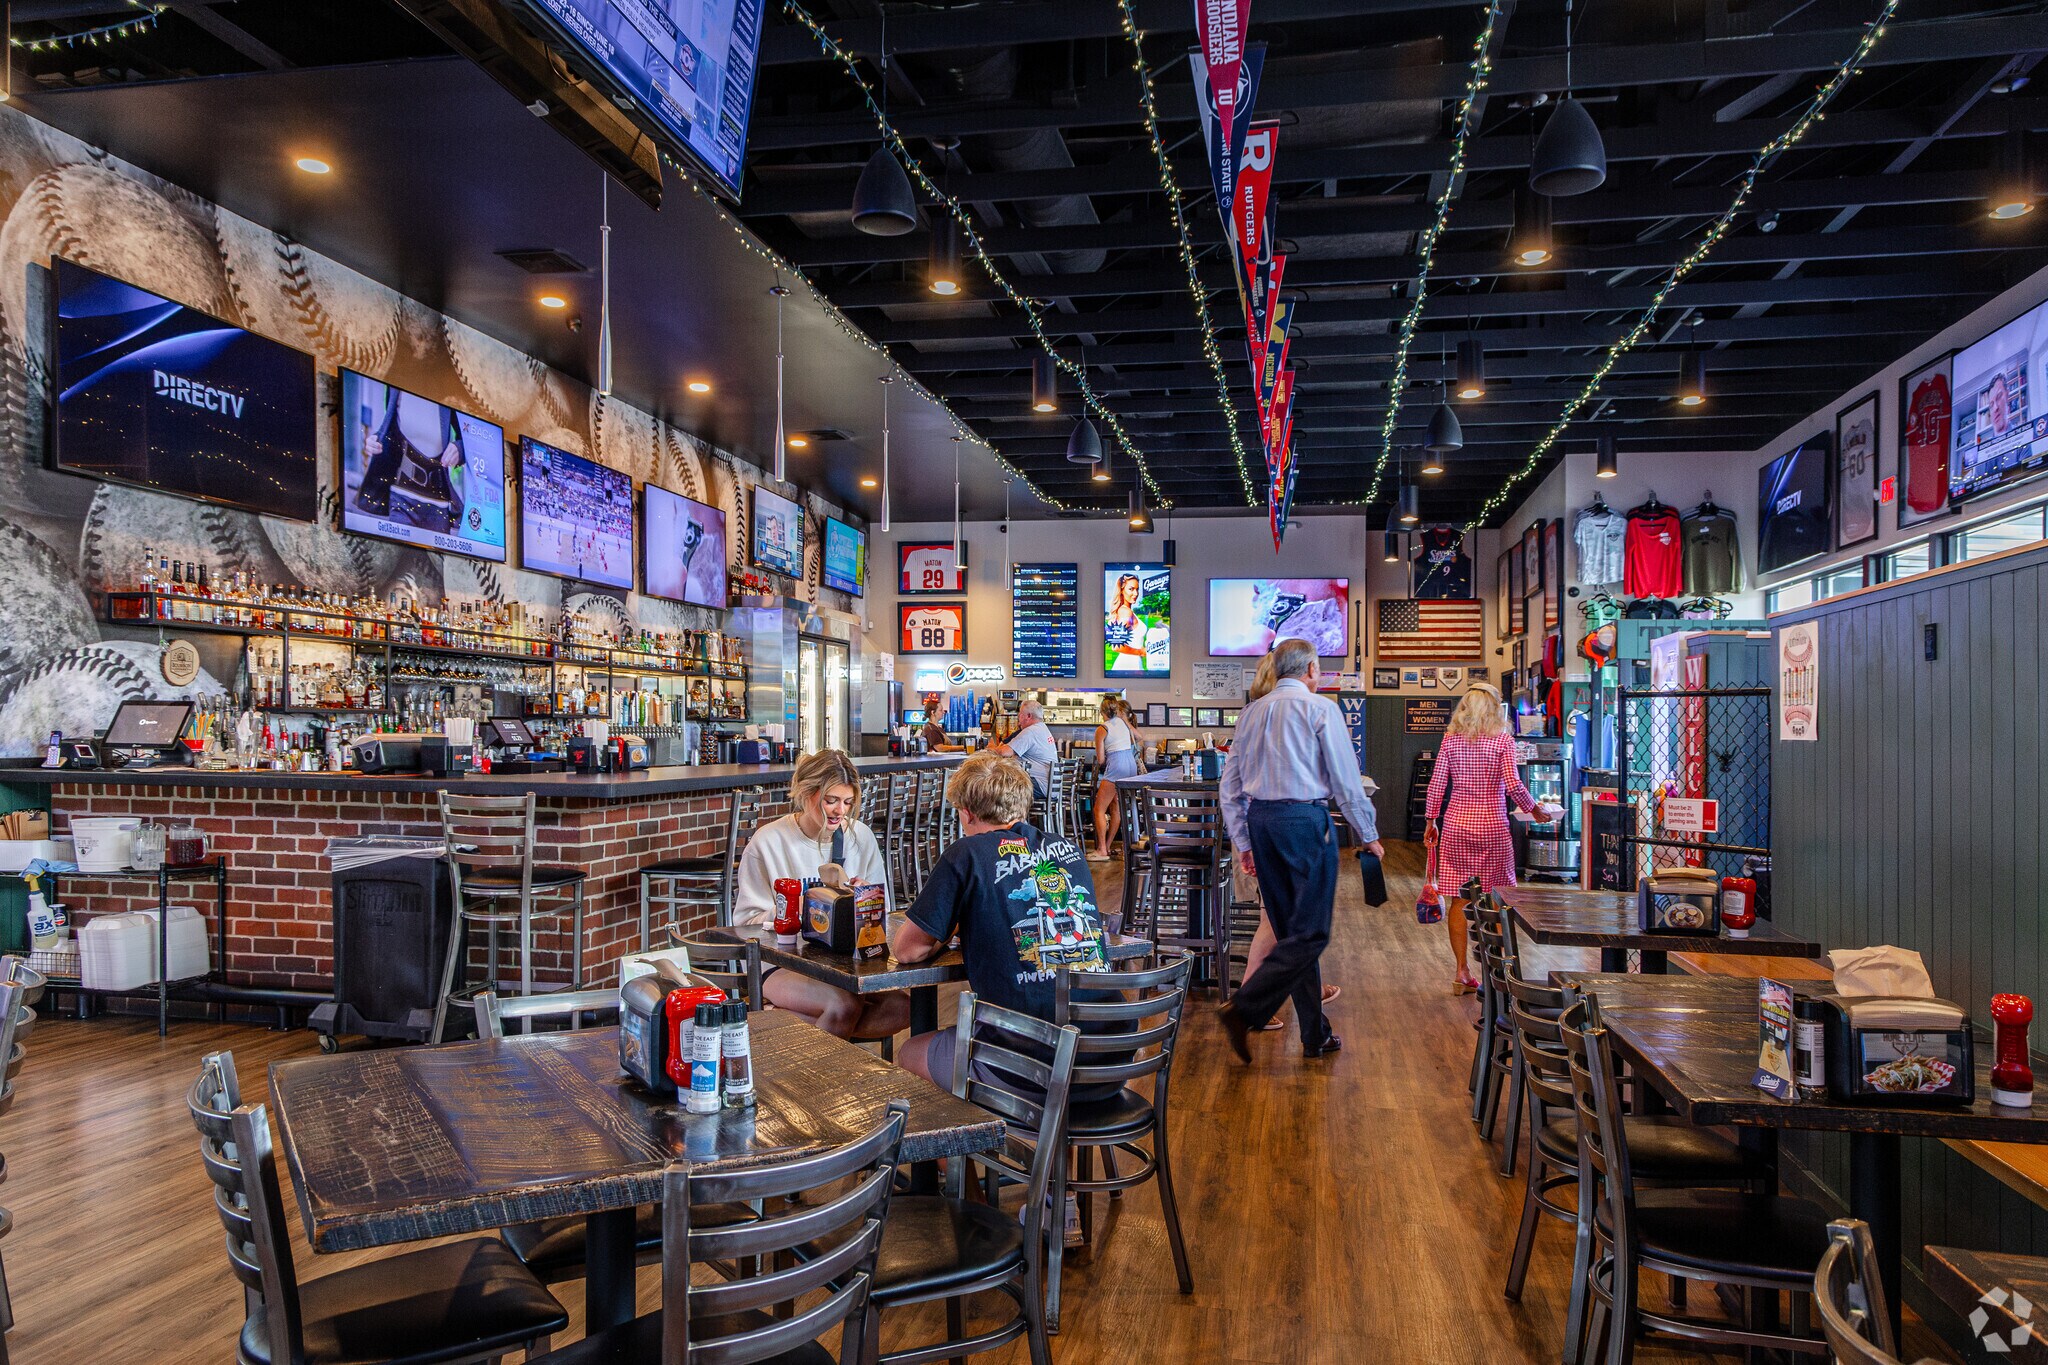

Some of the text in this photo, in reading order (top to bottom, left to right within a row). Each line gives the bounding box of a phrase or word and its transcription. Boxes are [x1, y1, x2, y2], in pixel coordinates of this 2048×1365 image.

[564, 12, 585, 36] SERIES
[583, 29, 599, 49] OVER
[596, 42, 610, 60] SPAN
[574, 11, 594, 34] SINCE
[594, 27, 609, 47] JUNE
[658, 17, 677, 37] SHOW
[1220, 0, 1241, 65] NDIANA
[1218, 88, 1233, 106] IU
[1221, 158, 1232, 193] STATE
[1244, 186, 1256, 246] RUTGERS
[1265, 353, 1275, 387] MICHIGAN
[153, 369, 245, 419] DIRECTV
[473, 456, 485, 473] 29
[1777, 490, 1802, 515] DIRECTV
[377, 521, 411, 537] GetXBack.com
[434, 535, 473, 552] 800-203-5606
[924, 559, 943, 567] MATON
[1443, 566, 1451, 576] 9
[923, 569, 944, 589] 29
[1143, 574, 1170, 592] Garage
[922, 618, 942, 627] MATON
[921, 628, 945, 648] 88
[967, 666, 1004, 682] pepsi
[1412, 716, 1445, 724] WOMEN
[1000, 844, 1028, 855] ON DUTY
[1600, 833, 1619, 850] THA
